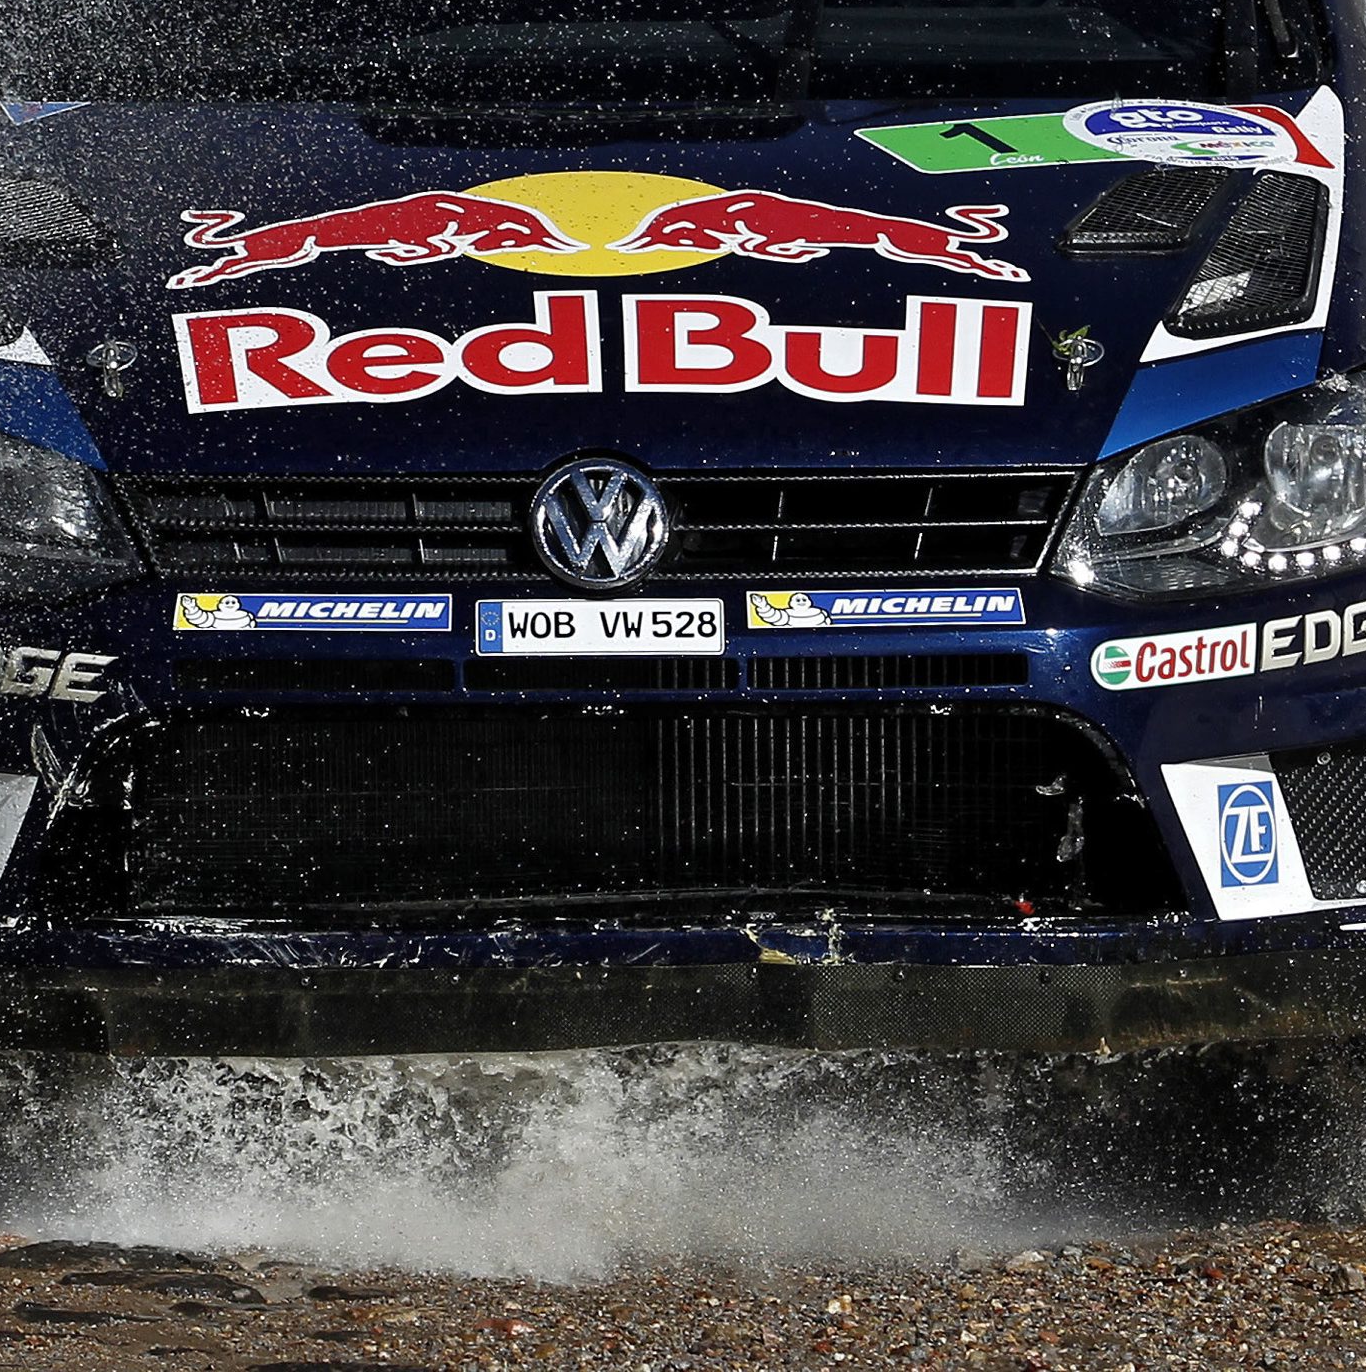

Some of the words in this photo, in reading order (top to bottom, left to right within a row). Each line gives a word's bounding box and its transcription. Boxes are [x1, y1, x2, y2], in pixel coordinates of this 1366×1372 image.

[939, 123, 1019, 154] 1
[1211, 125, 1263, 134] Rally
[187, 296, 587, 404] Red
[637, 299, 1022, 399] Bull
[258, 602, 446, 618] MICHELIN
[831, 596, 1015, 614] MICHELIN
[484, 629, 495, 641] D
[509, 612, 576, 638] WOB
[1136, 630, 1250, 682] Castrol
[1228, 804, 1270, 863] ZF
